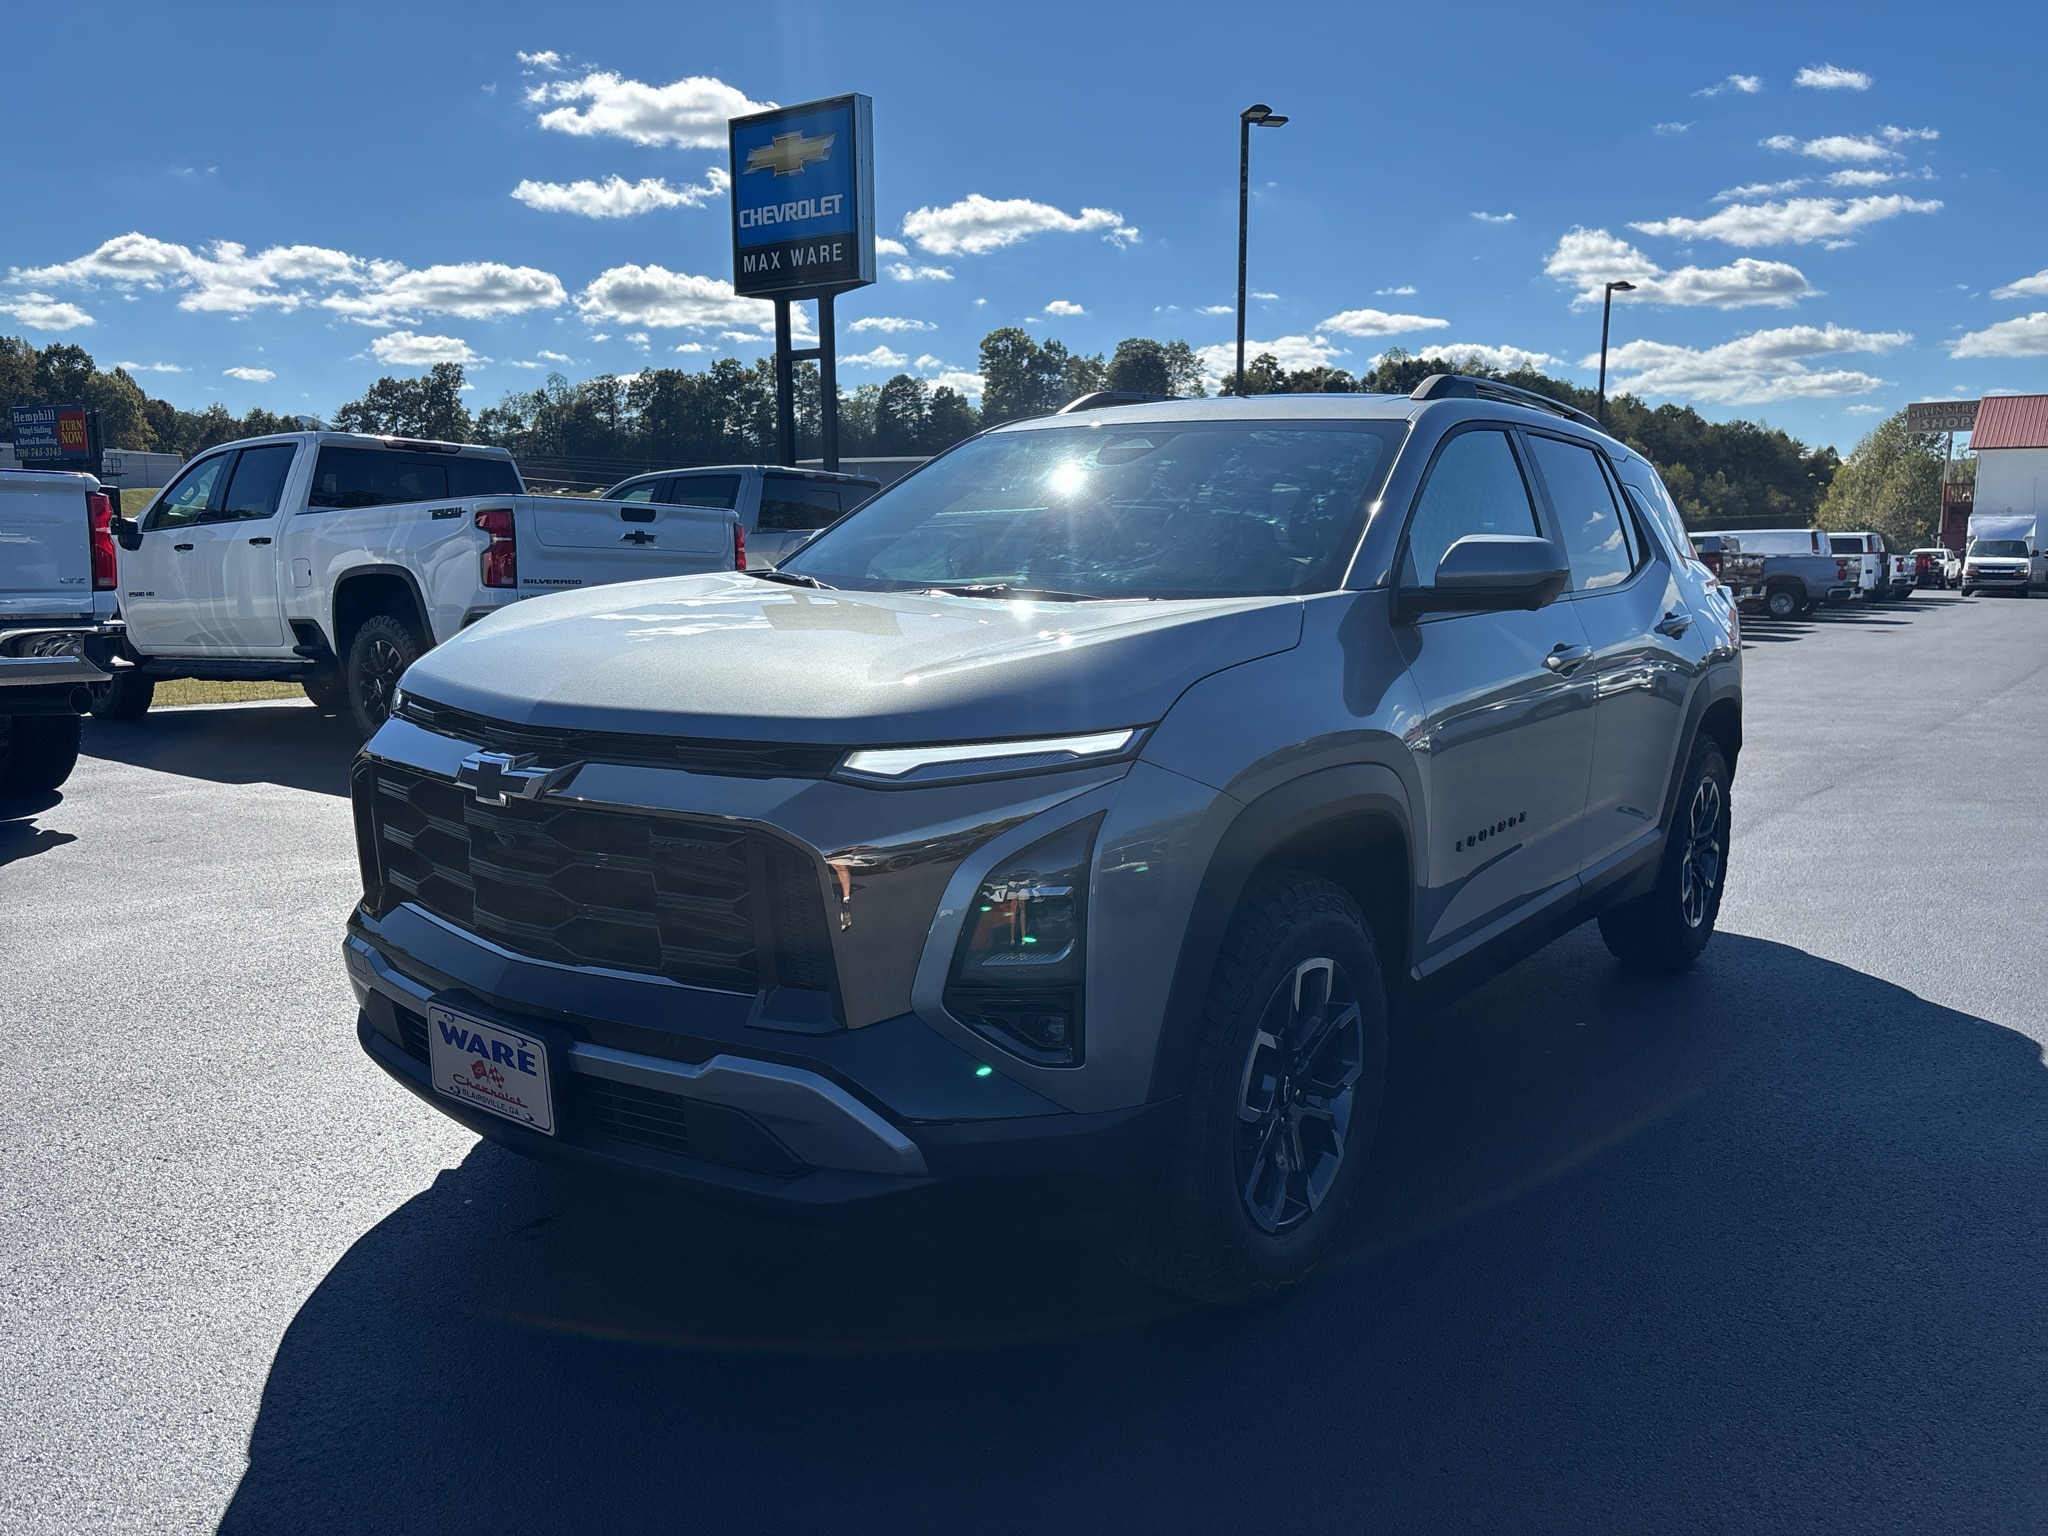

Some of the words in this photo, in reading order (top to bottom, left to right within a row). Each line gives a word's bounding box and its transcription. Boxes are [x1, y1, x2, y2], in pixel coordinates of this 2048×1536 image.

[739, 194, 843, 229] CHEVROLET
[743, 251, 781, 273] MAX
[790, 243, 843, 267] WARE
[13, 409, 55, 423] Hemphill
[1910, 405, 1944, 420] MAIN
[1946, 404, 1979, 414] STRE
[60, 420, 82, 431] TURN
[1921, 416, 1977, 429] SHOP
[19, 426, 34, 436] Vinyl
[34, 426, 52, 435] Siding
[61, 431, 83, 443] NOW
[20, 437, 35, 445] Metal
[36, 437, 58, 445] Roofing
[16, 447, 62, 457] 706-745-3145
[1455, 810, 1527, 852] EQUINOX
[437, 1020, 537, 1077] WARE
[452, 1073, 529, 1109] Chevrolet
[462, 1088, 507, 1112] BLAIRSVILLE,
[508, 1106, 520, 1116] GA
